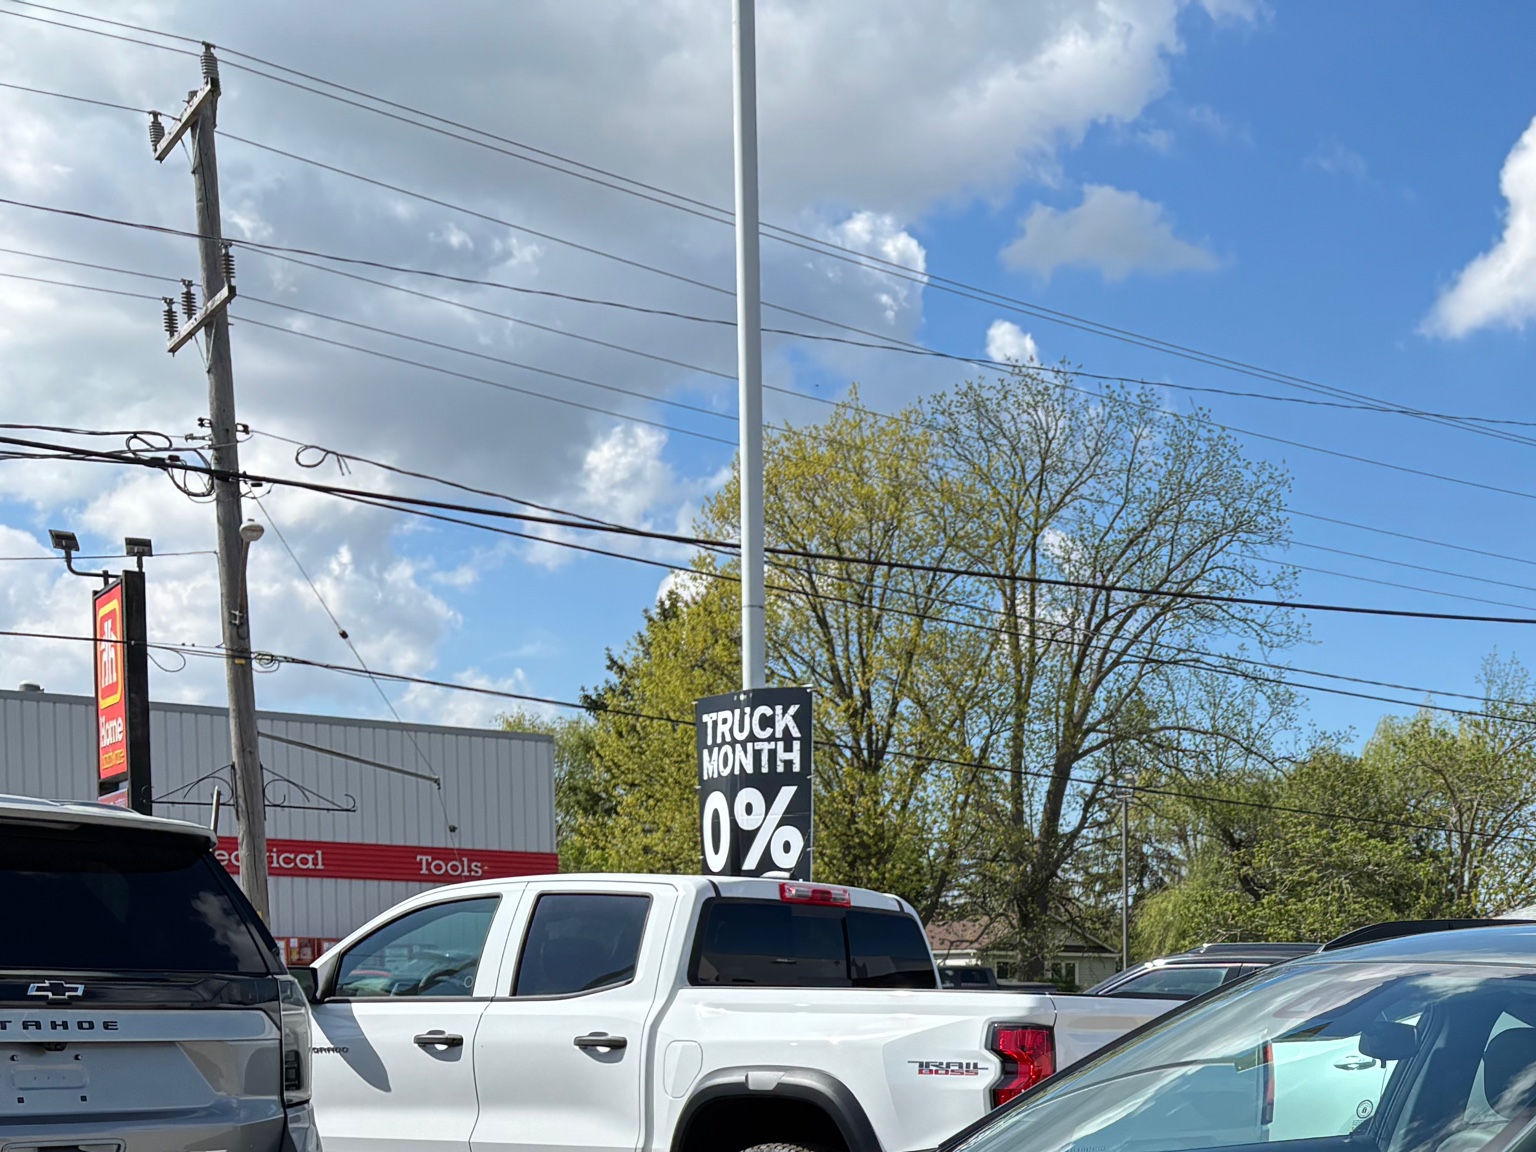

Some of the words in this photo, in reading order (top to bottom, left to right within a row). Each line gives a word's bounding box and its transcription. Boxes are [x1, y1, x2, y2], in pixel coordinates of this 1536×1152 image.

[702, 704, 802, 746] TRUCK
[702, 740, 801, 780] MONTH
[703, 786, 804, 873] 0%
[416, 855, 483, 877] Tools
[0, 1020, 119, 1031] TAHOE
[907, 1060, 988, 1071] TRAIL
